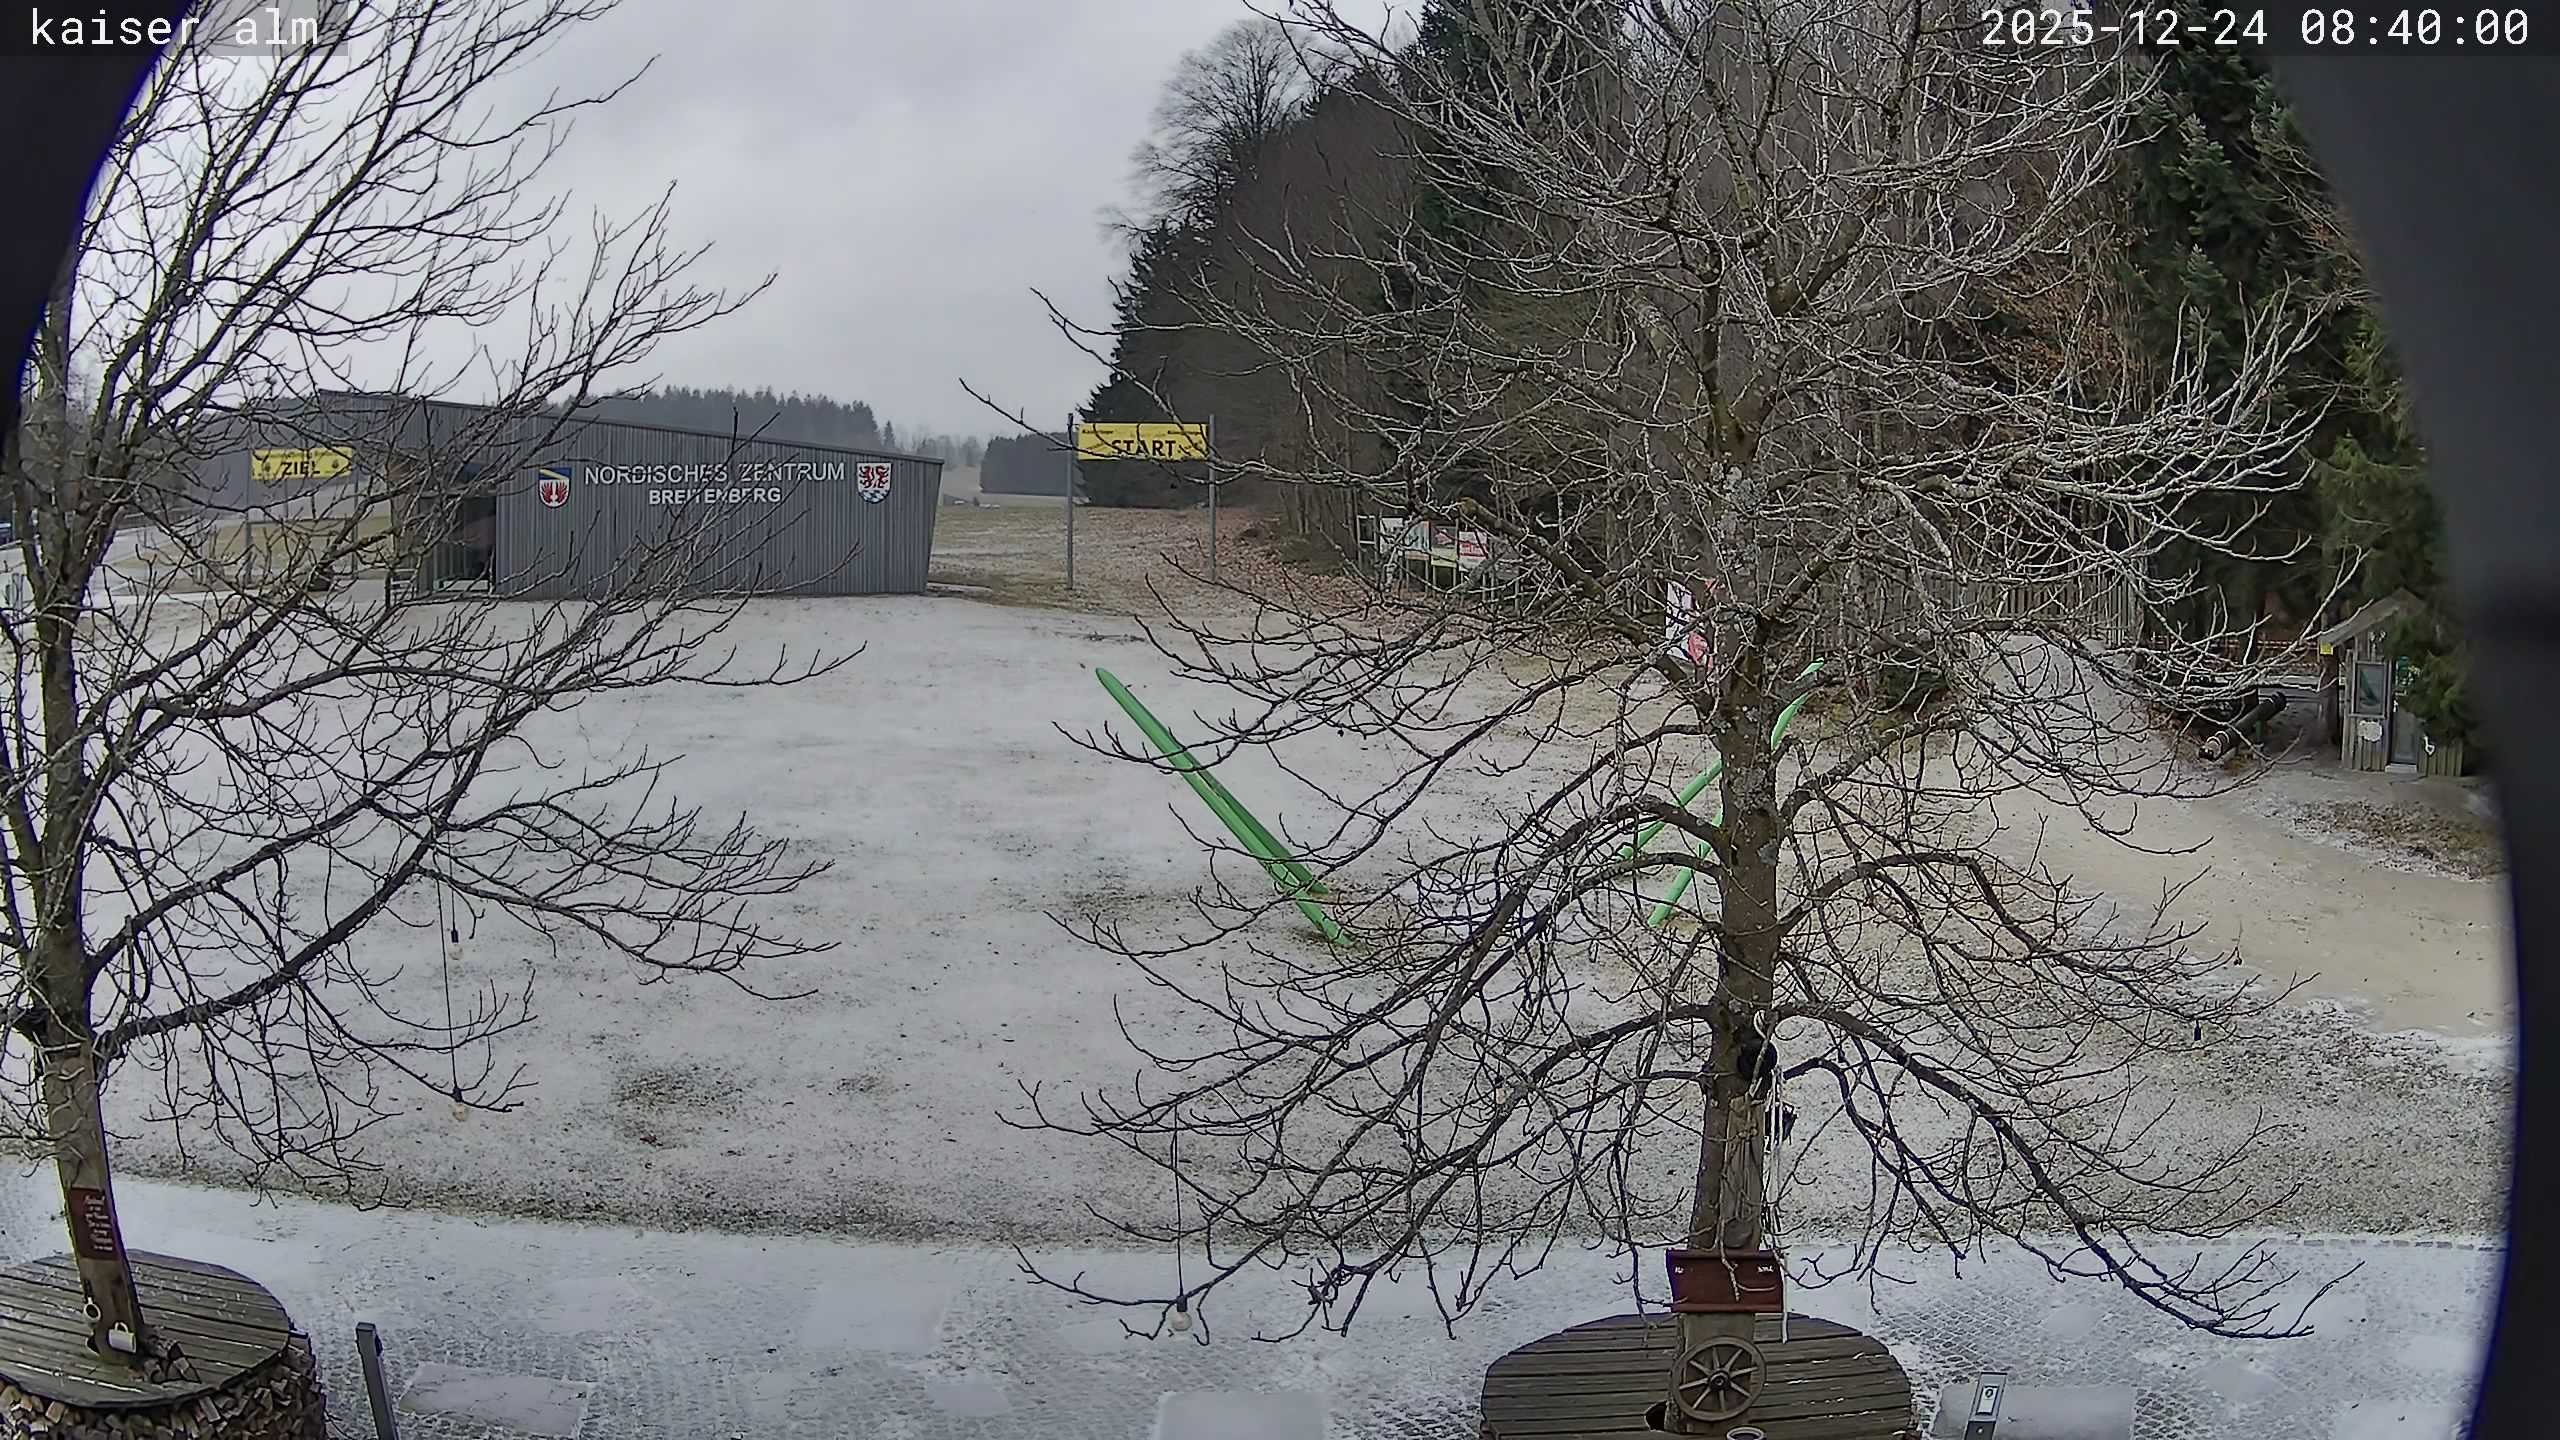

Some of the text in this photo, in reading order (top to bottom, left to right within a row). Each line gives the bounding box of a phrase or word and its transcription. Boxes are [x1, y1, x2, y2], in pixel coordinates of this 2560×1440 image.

[1111, 440, 1177, 457] START
[281, 461, 320, 475] ZIEL
[585, 463, 845, 485] NORDISCHES ZENTRUM
